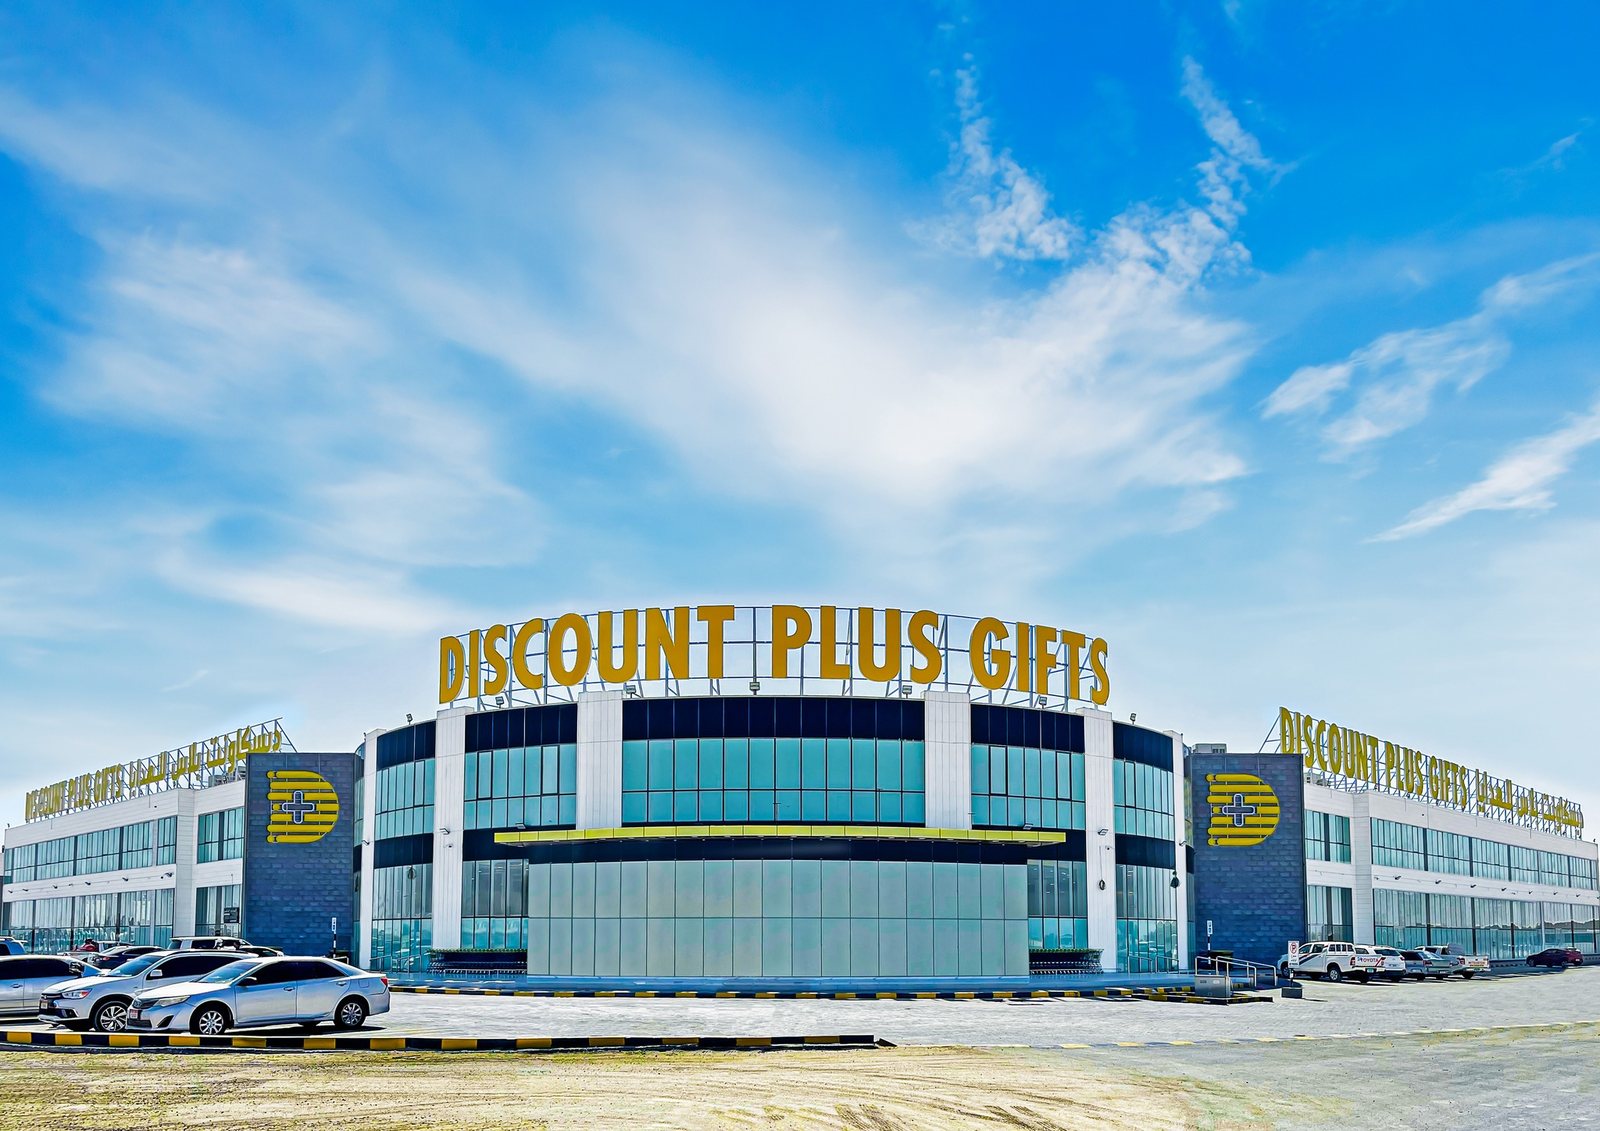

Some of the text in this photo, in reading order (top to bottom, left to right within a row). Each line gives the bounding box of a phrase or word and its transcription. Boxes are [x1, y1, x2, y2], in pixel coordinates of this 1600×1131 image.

[439, 604, 1111, 705] DISCOUNT PLUS GIFTS
[68, 773, 92, 808] PLUS
[94, 763, 123, 803] GIFTS
[1279, 706, 1467, 809] DISCOUNT PLUS GIFTS
